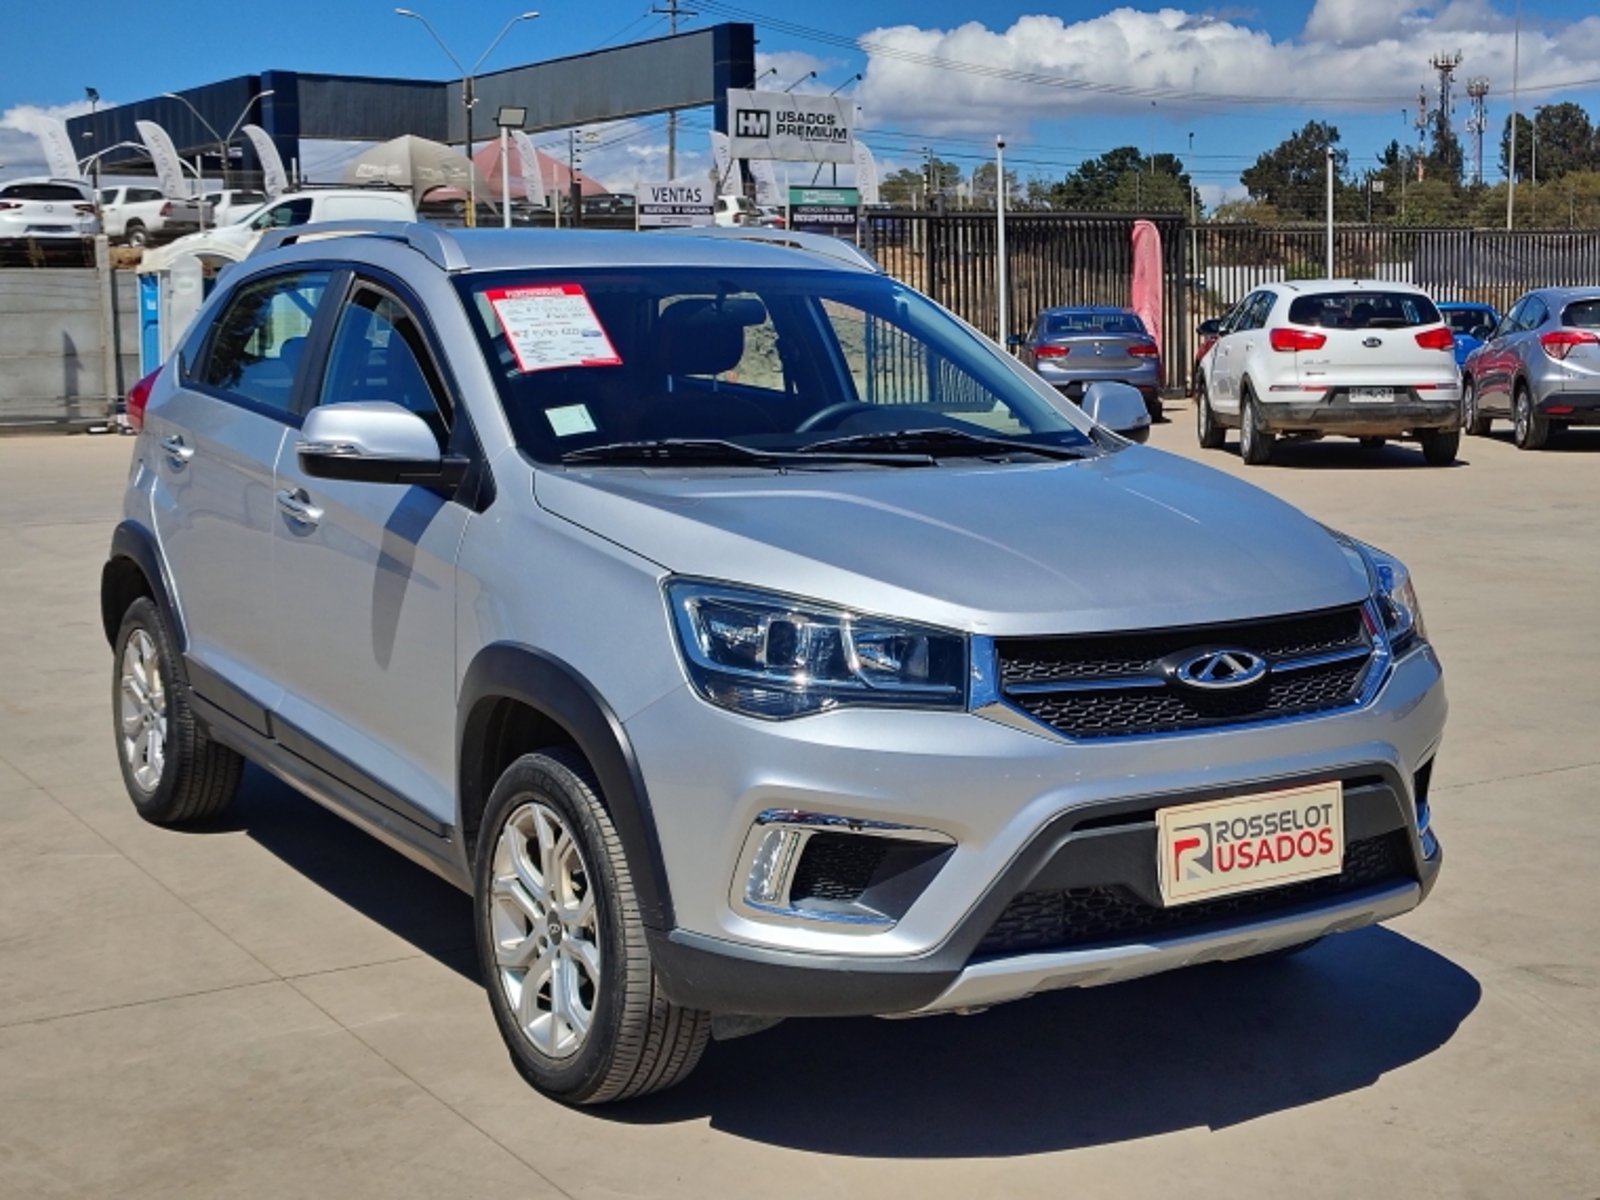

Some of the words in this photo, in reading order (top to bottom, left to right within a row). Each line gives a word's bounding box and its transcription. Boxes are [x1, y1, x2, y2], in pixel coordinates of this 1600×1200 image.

[776, 111, 836, 126] USADOS
[776, 124, 847, 139] PREMIUM
[651, 187, 702, 203] VENTAS
[1216, 804, 1333, 843] ROSSELOT
[1215, 828, 1334, 872] USADOS
